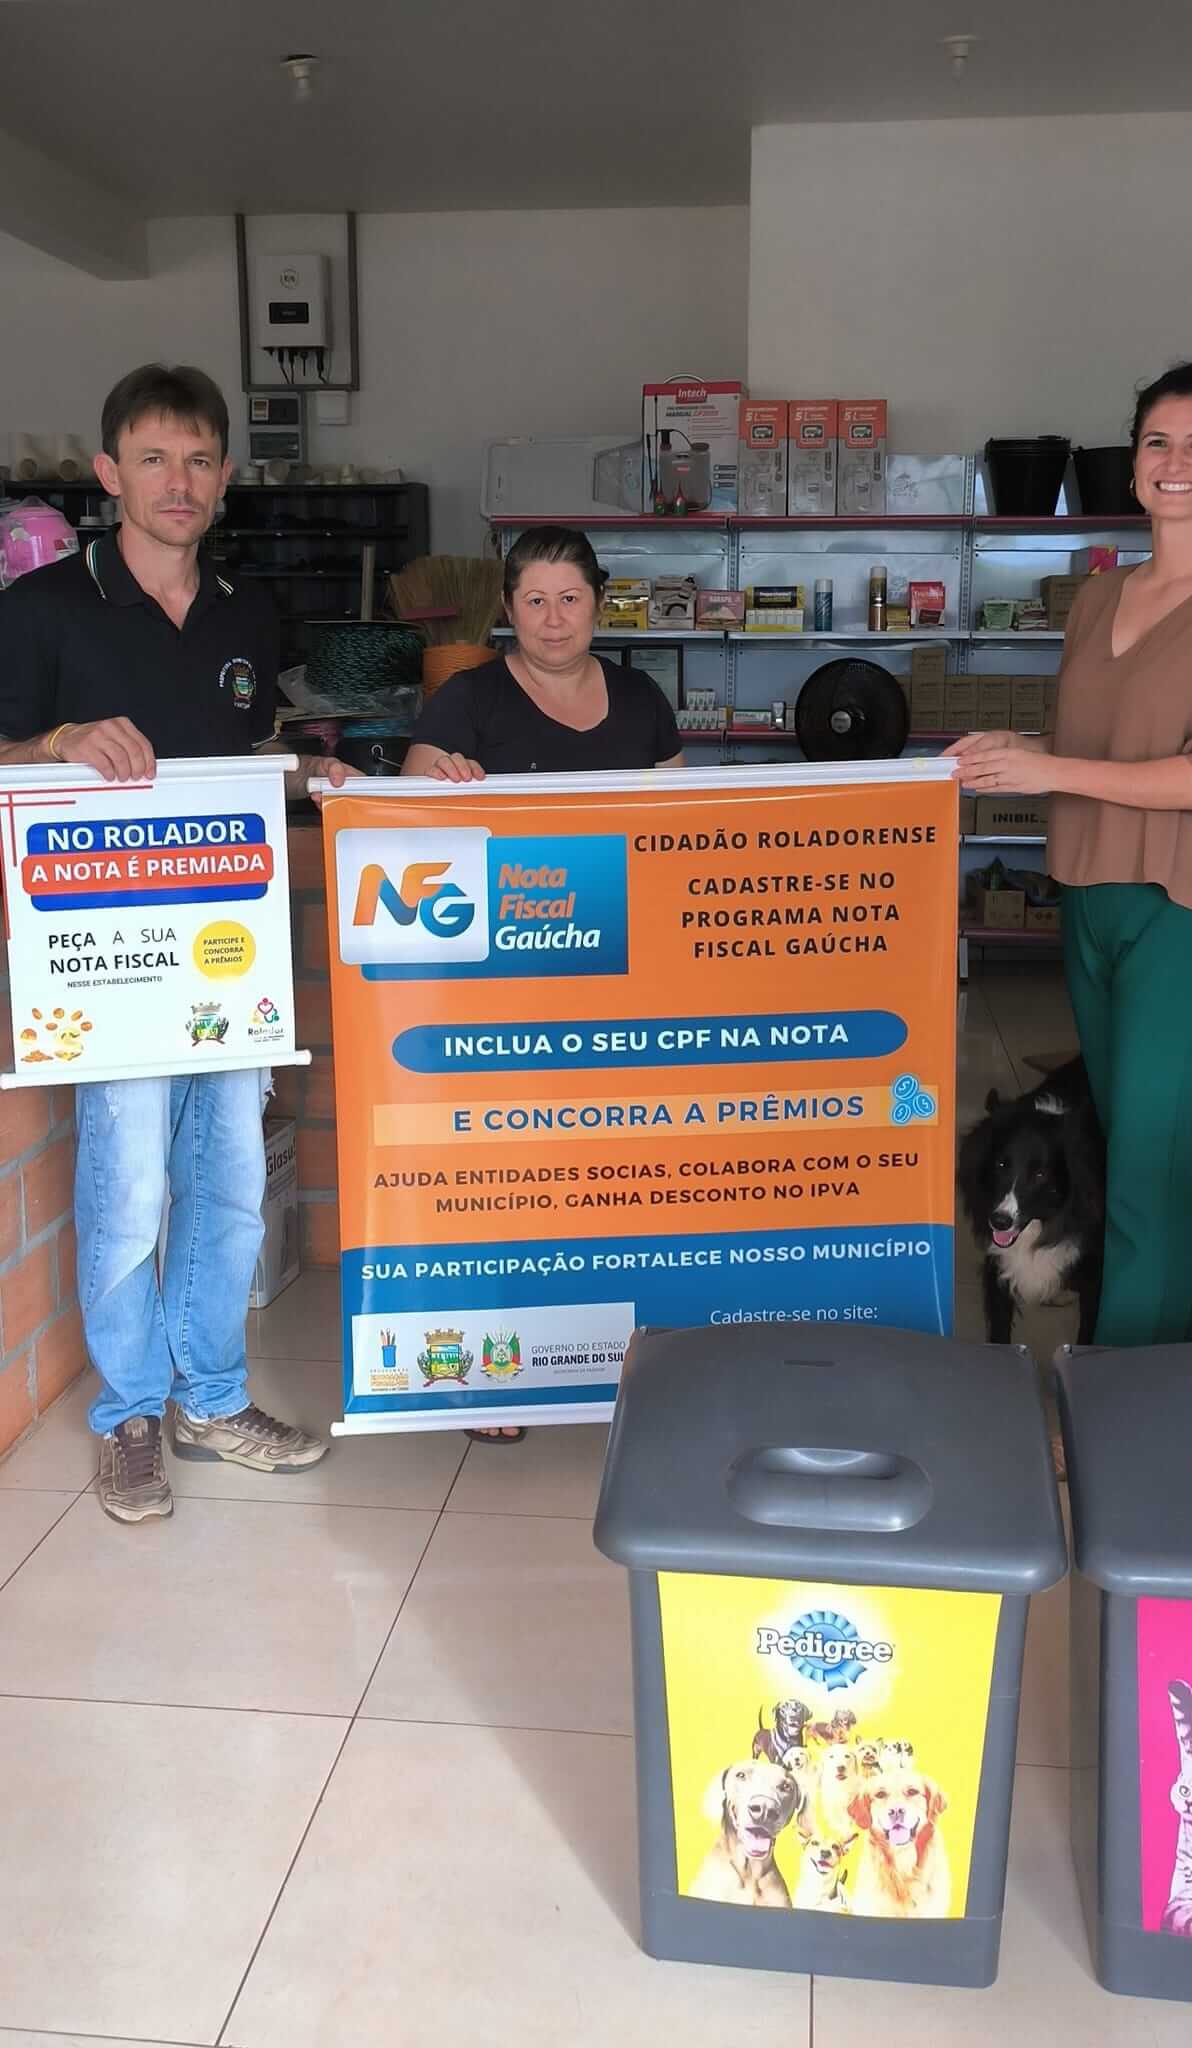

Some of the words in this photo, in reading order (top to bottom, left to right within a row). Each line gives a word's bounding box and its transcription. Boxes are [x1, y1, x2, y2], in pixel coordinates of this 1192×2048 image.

[678, 387, 707, 398] Intech
[47, 827, 94, 851] NO
[104, 820, 248, 848] ROLADOR
[634, 828, 748, 852] CIDADÃO
[758, 826, 936, 849] ROLADORENSE
[31, 865, 48, 883] A
[55, 861, 121, 881] NOTA
[127, 856, 139, 878] É
[147, 853, 265, 876] PREMIADA
[498, 863, 568, 889] Nota
[688, 873, 850, 895] CADASTRE-SE
[860, 872, 895, 889] NO
[352, 861, 476, 939] NFG
[498, 892, 577, 920] Fiscal
[681, 906, 823, 928] PROGRAMA
[832, 904, 900, 922] NOTA
[48, 932, 97, 951] PEÇA
[112, 930, 125, 944] A
[140, 928, 177, 943] SUA
[203, 937, 239, 945] PARTICIPE
[495, 922, 601, 950] Gaúcha
[694, 939, 776, 958] FISCAL
[786, 932, 887, 955] GAÚCHA
[50, 955, 108, 974] NOTA
[114, 951, 180, 969] FISCAL
[203, 947, 245, 955] CONCORRA
[67, 980, 91, 988] NESSE
[93, 976, 163, 986] ESTABELECIMENTO
[445, 1034, 552, 1056] INCLUA
[562, 1034, 583, 1053] O
[592, 1031, 647, 1052] SEU
[657, 1029, 711, 1050] CPF
[720, 1027, 761, 1048] NA
[770, 1024, 848, 1046] NOTA
[454, 1110, 472, 1131] E
[484, 1104, 673, 1130] CONCORRA
[684, 1103, 705, 1124] A
[718, 1094, 864, 1122] PRÊMIOS
[374, 1171, 448, 1188] AJUDA
[455, 1167, 579, 1185] ENTIDADES
[586, 1164, 672, 1181] SOCIAS,
[679, 1157, 796, 1177] COLABORA
[803, 1155, 849, 1171] COM
[857, 1154, 871, 1169] O
[878, 1152, 919, 1167] SEU
[436, 1192, 558, 1213] MUNICÍPIO,
[565, 1191, 643, 1208] GANHA
[650, 1186, 766, 1205] DESCONTO
[774, 1184, 803, 1199] NO
[811, 1181, 860, 1197] IPVA
[361, 1263, 408, 1280] SUA
[415, 1252, 585, 1278] PARTICIPAÇÃO
[592, 1247, 722, 1270] FORTALECE
[729, 1245, 806, 1265] NOSSO
[813, 1238, 931, 1260] MUNICÍPIO
[711, 1307, 811, 1325] Cadastre-se
[817, 1308, 838, 1321] no
[843, 1304, 878, 1320] site:
[531, 1343, 575, 1354] GOVERNO
[577, 1342, 590, 1351] DO
[592, 1340, 626, 1351] ESTADO
[532, 1356, 549, 1367] RIO
[551, 1354, 590, 1366] GRANDE
[592, 1353, 606, 1363] DO
[757, 1627, 893, 1664] Pedigree
